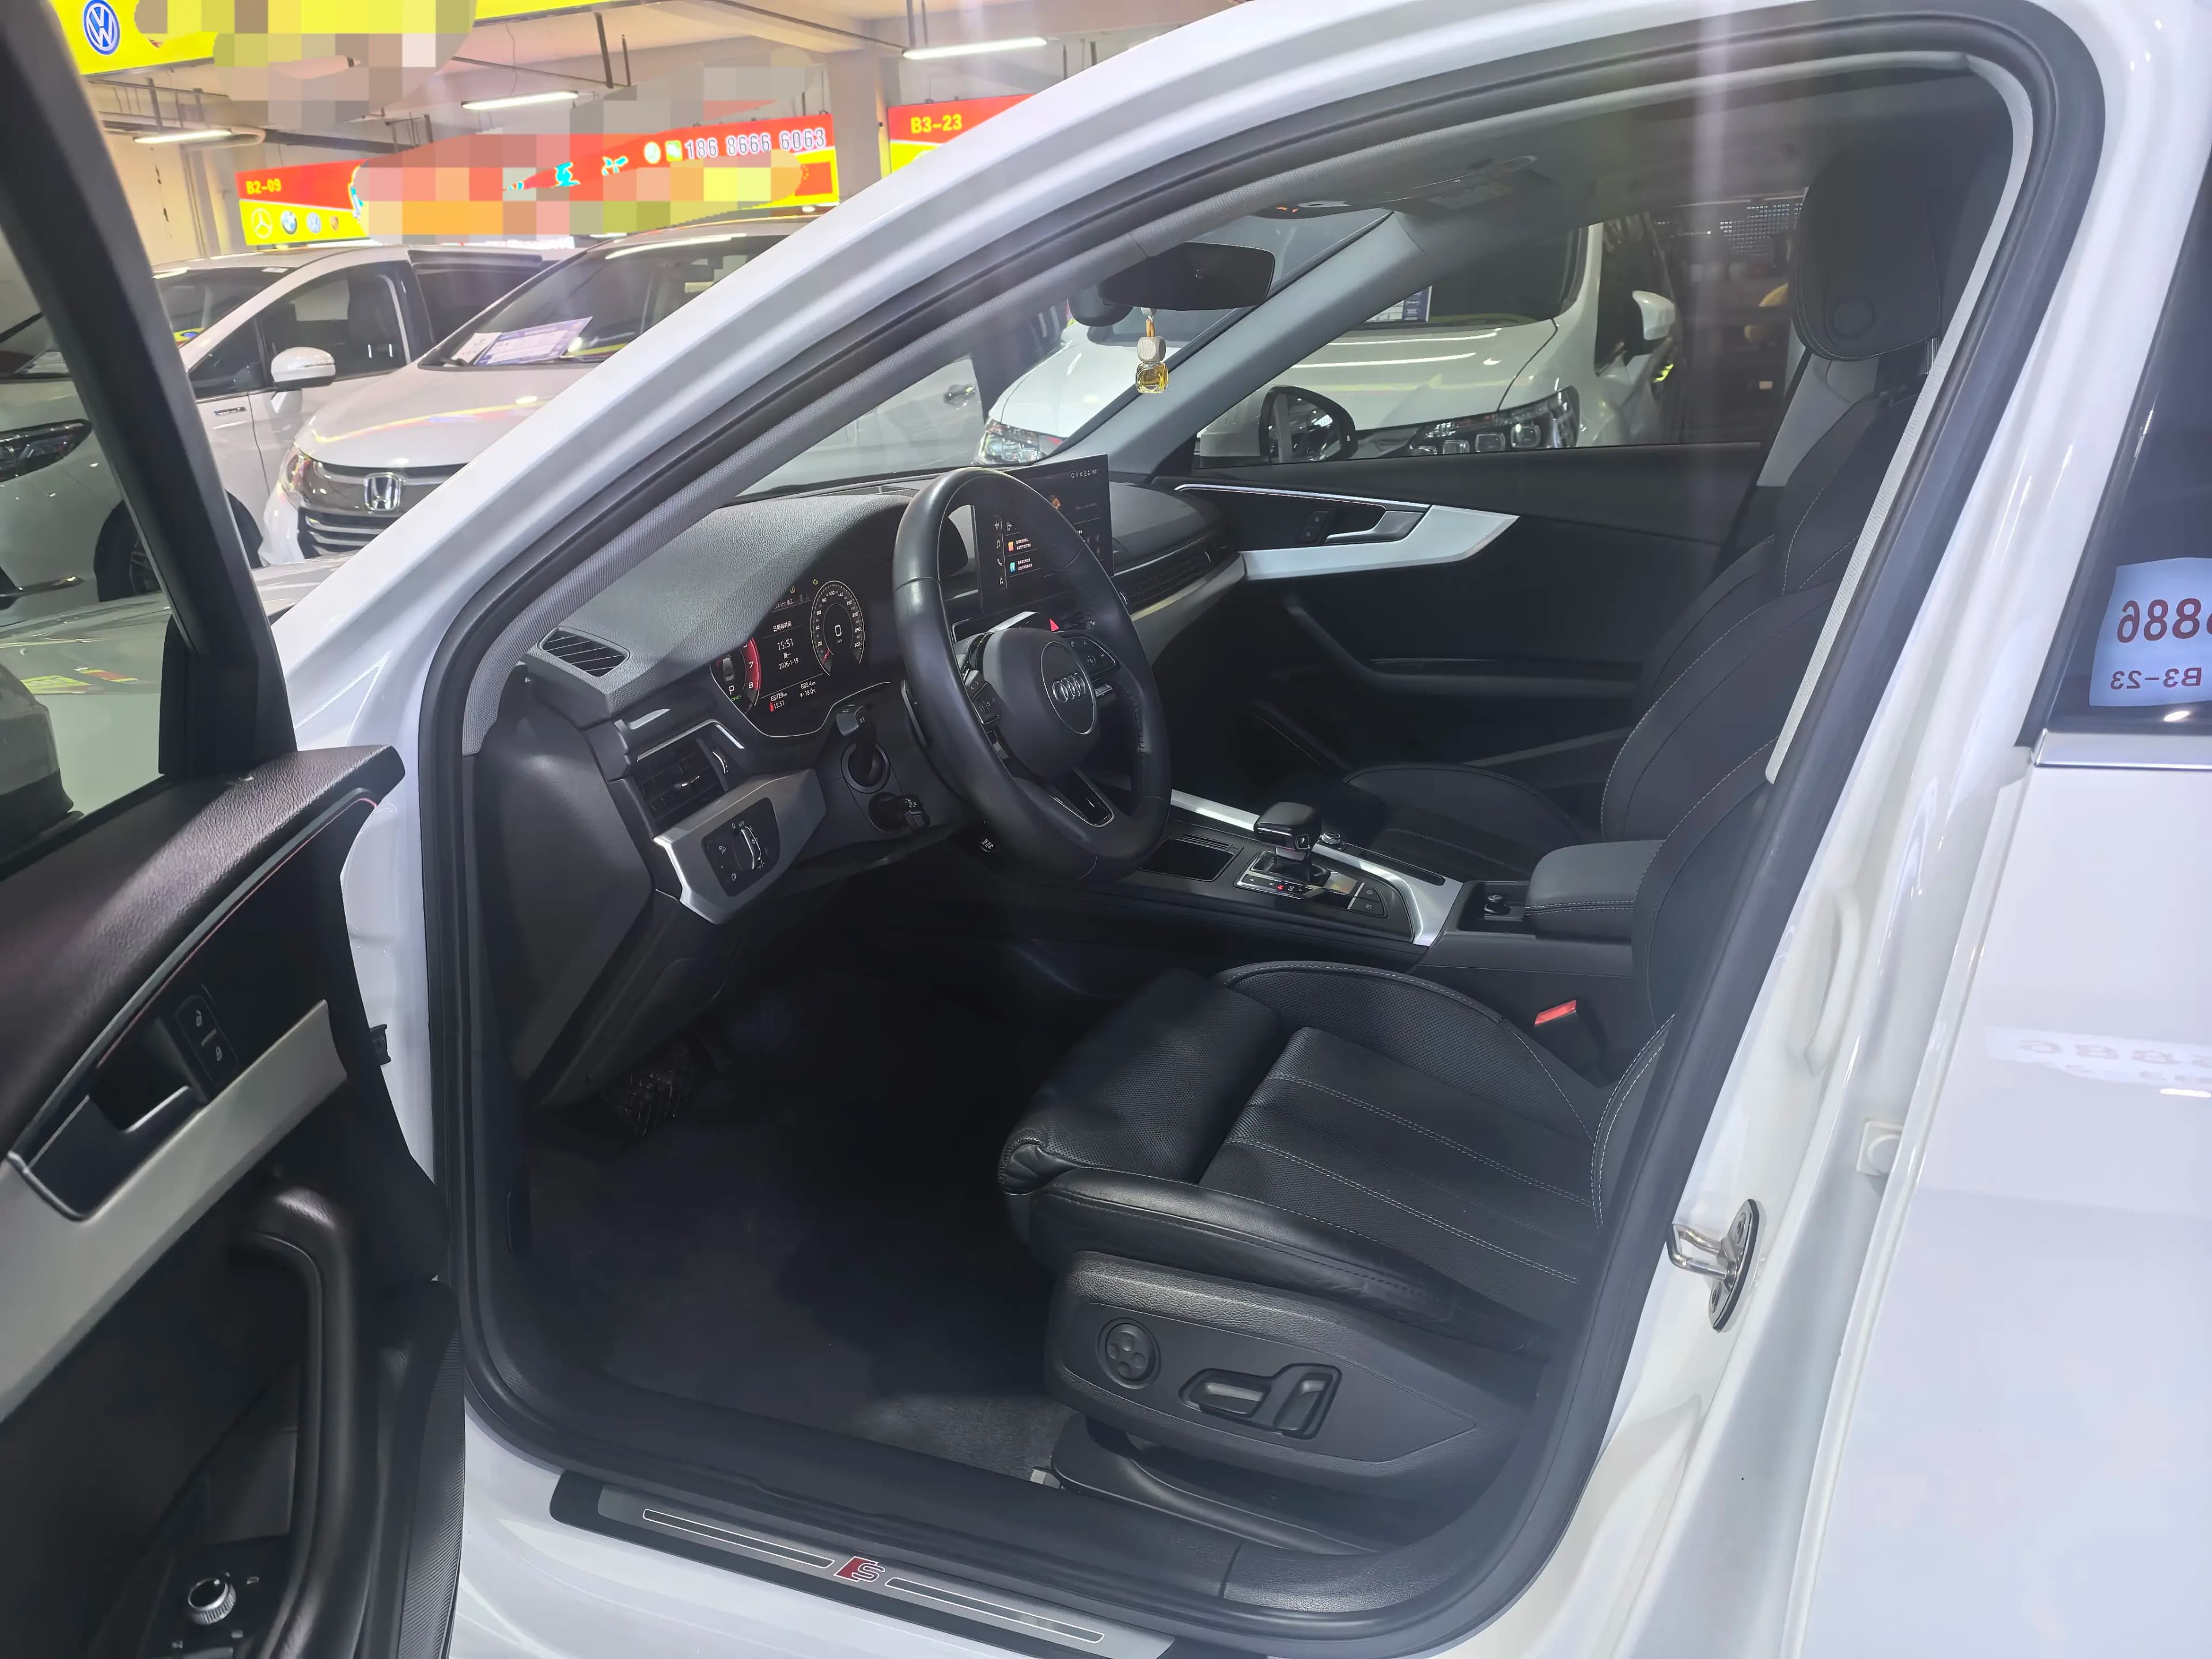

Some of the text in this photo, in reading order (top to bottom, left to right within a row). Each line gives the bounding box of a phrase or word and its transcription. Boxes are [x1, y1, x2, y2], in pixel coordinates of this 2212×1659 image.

[910, 113, 963, 134] B3-23
[684, 126, 827, 161] 186 8666 6063
[245, 178, 282, 195] B2-09
[748, 661, 754, 669] 7
[729, 685, 734, 695] P
